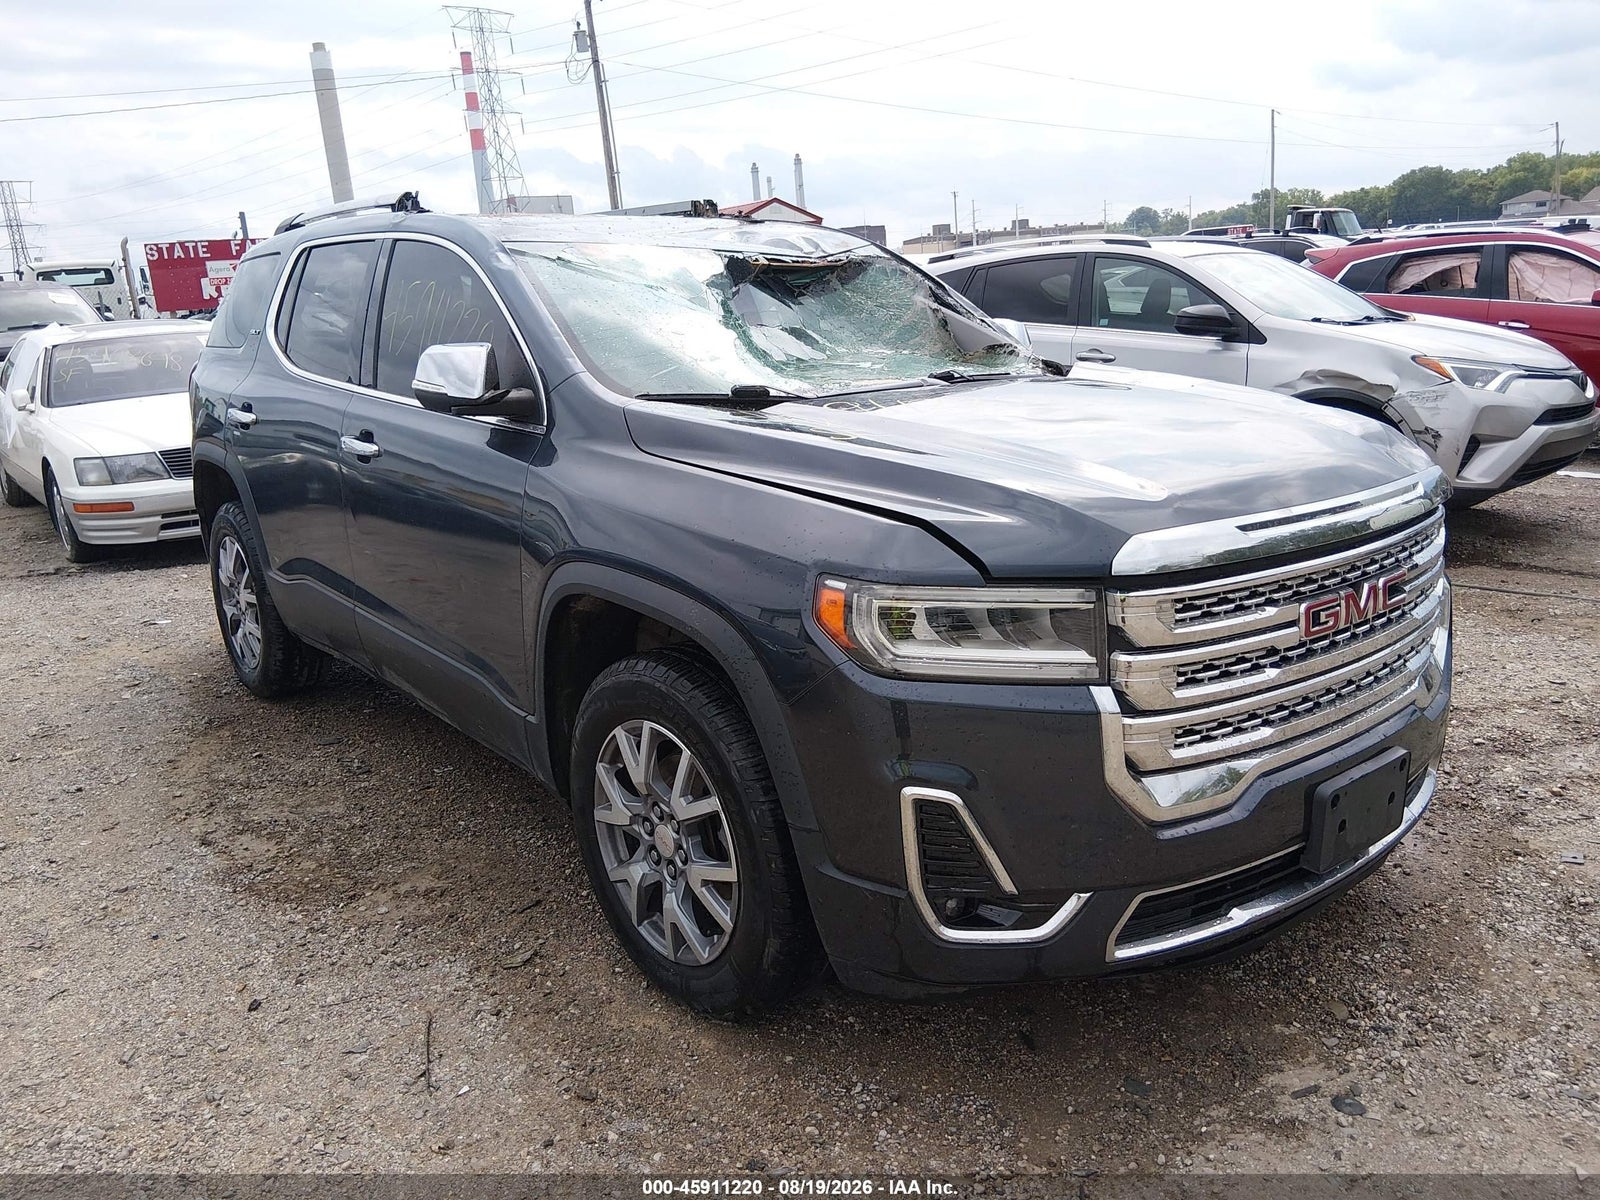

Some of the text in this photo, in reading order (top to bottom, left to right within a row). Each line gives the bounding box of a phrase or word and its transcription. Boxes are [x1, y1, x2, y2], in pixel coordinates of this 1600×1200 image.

[145, 239, 263, 261] STATE FA
[210, 278, 226, 286] DROP
[1300, 569, 1407, 640] GMC
